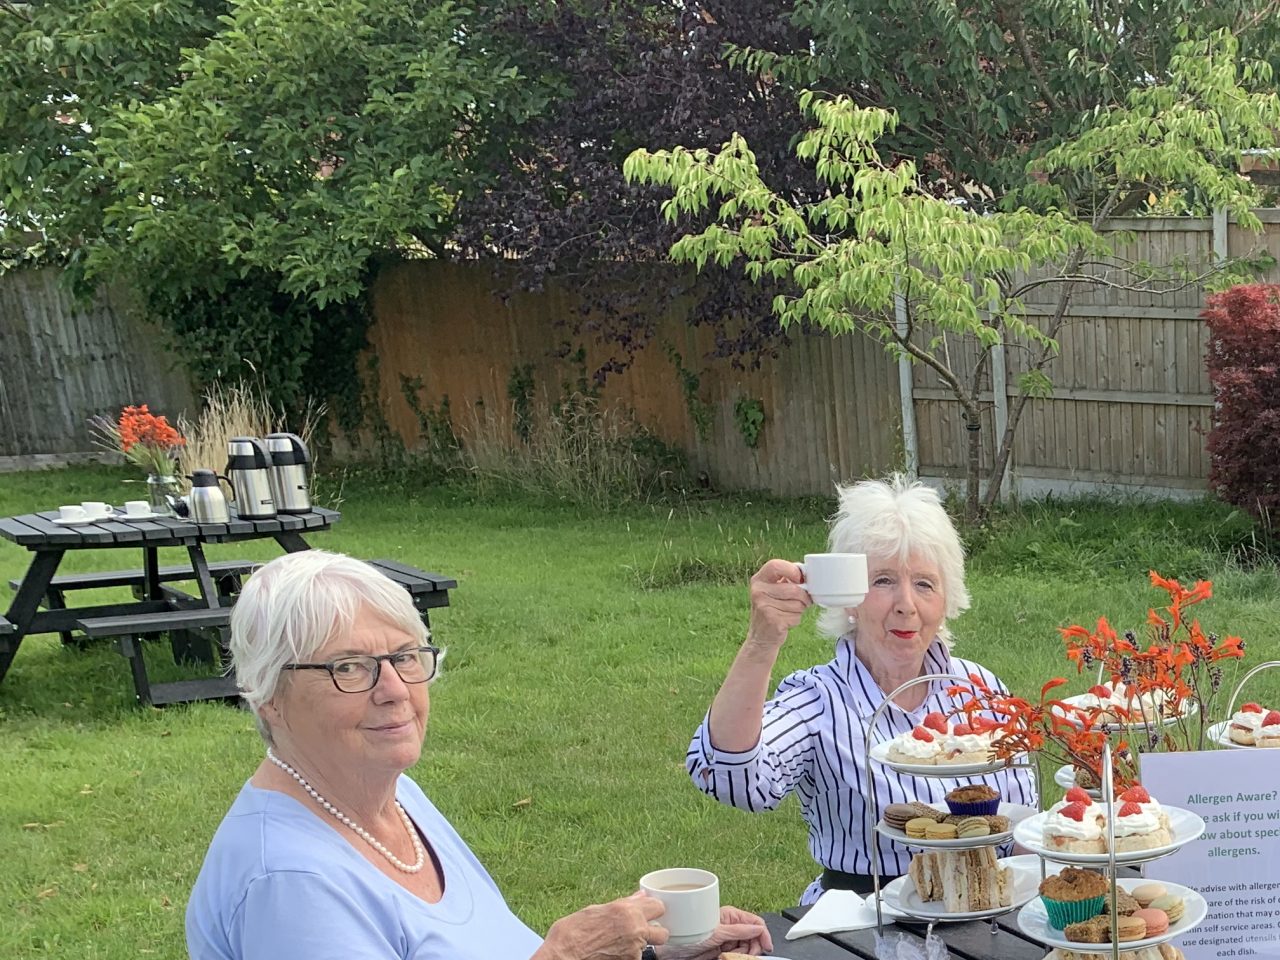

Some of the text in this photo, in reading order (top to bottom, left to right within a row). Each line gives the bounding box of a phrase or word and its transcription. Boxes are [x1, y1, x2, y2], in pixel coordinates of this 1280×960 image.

[1187, 790, 1278, 806] Allergen Aware?
[1212, 811, 1231, 823] ask
[1233, 810, 1242, 822] if
[1244, 812, 1264, 823] you
[1220, 828, 1253, 840] about
[1207, 846, 1261, 859] allergens.
[1200, 884, 1227, 893] advise
[1228, 882, 1247, 892] with
[1224, 898, 1234, 907] of
[1235, 897, 1249, 906] the
[1251, 896, 1266, 905] risk
[1267, 896, 1277, 904] of
[1236, 909, 1253, 918] that
[1255, 910, 1273, 918] may
[1204, 924, 1218, 933] self
[1221, 923, 1249, 932] service
[1251, 921, 1275, 930] areas.
[1199, 935, 1243, 946] designated
[1246, 934, 1276, 943] utensils
[1216, 947, 1257, 957] each dish.
